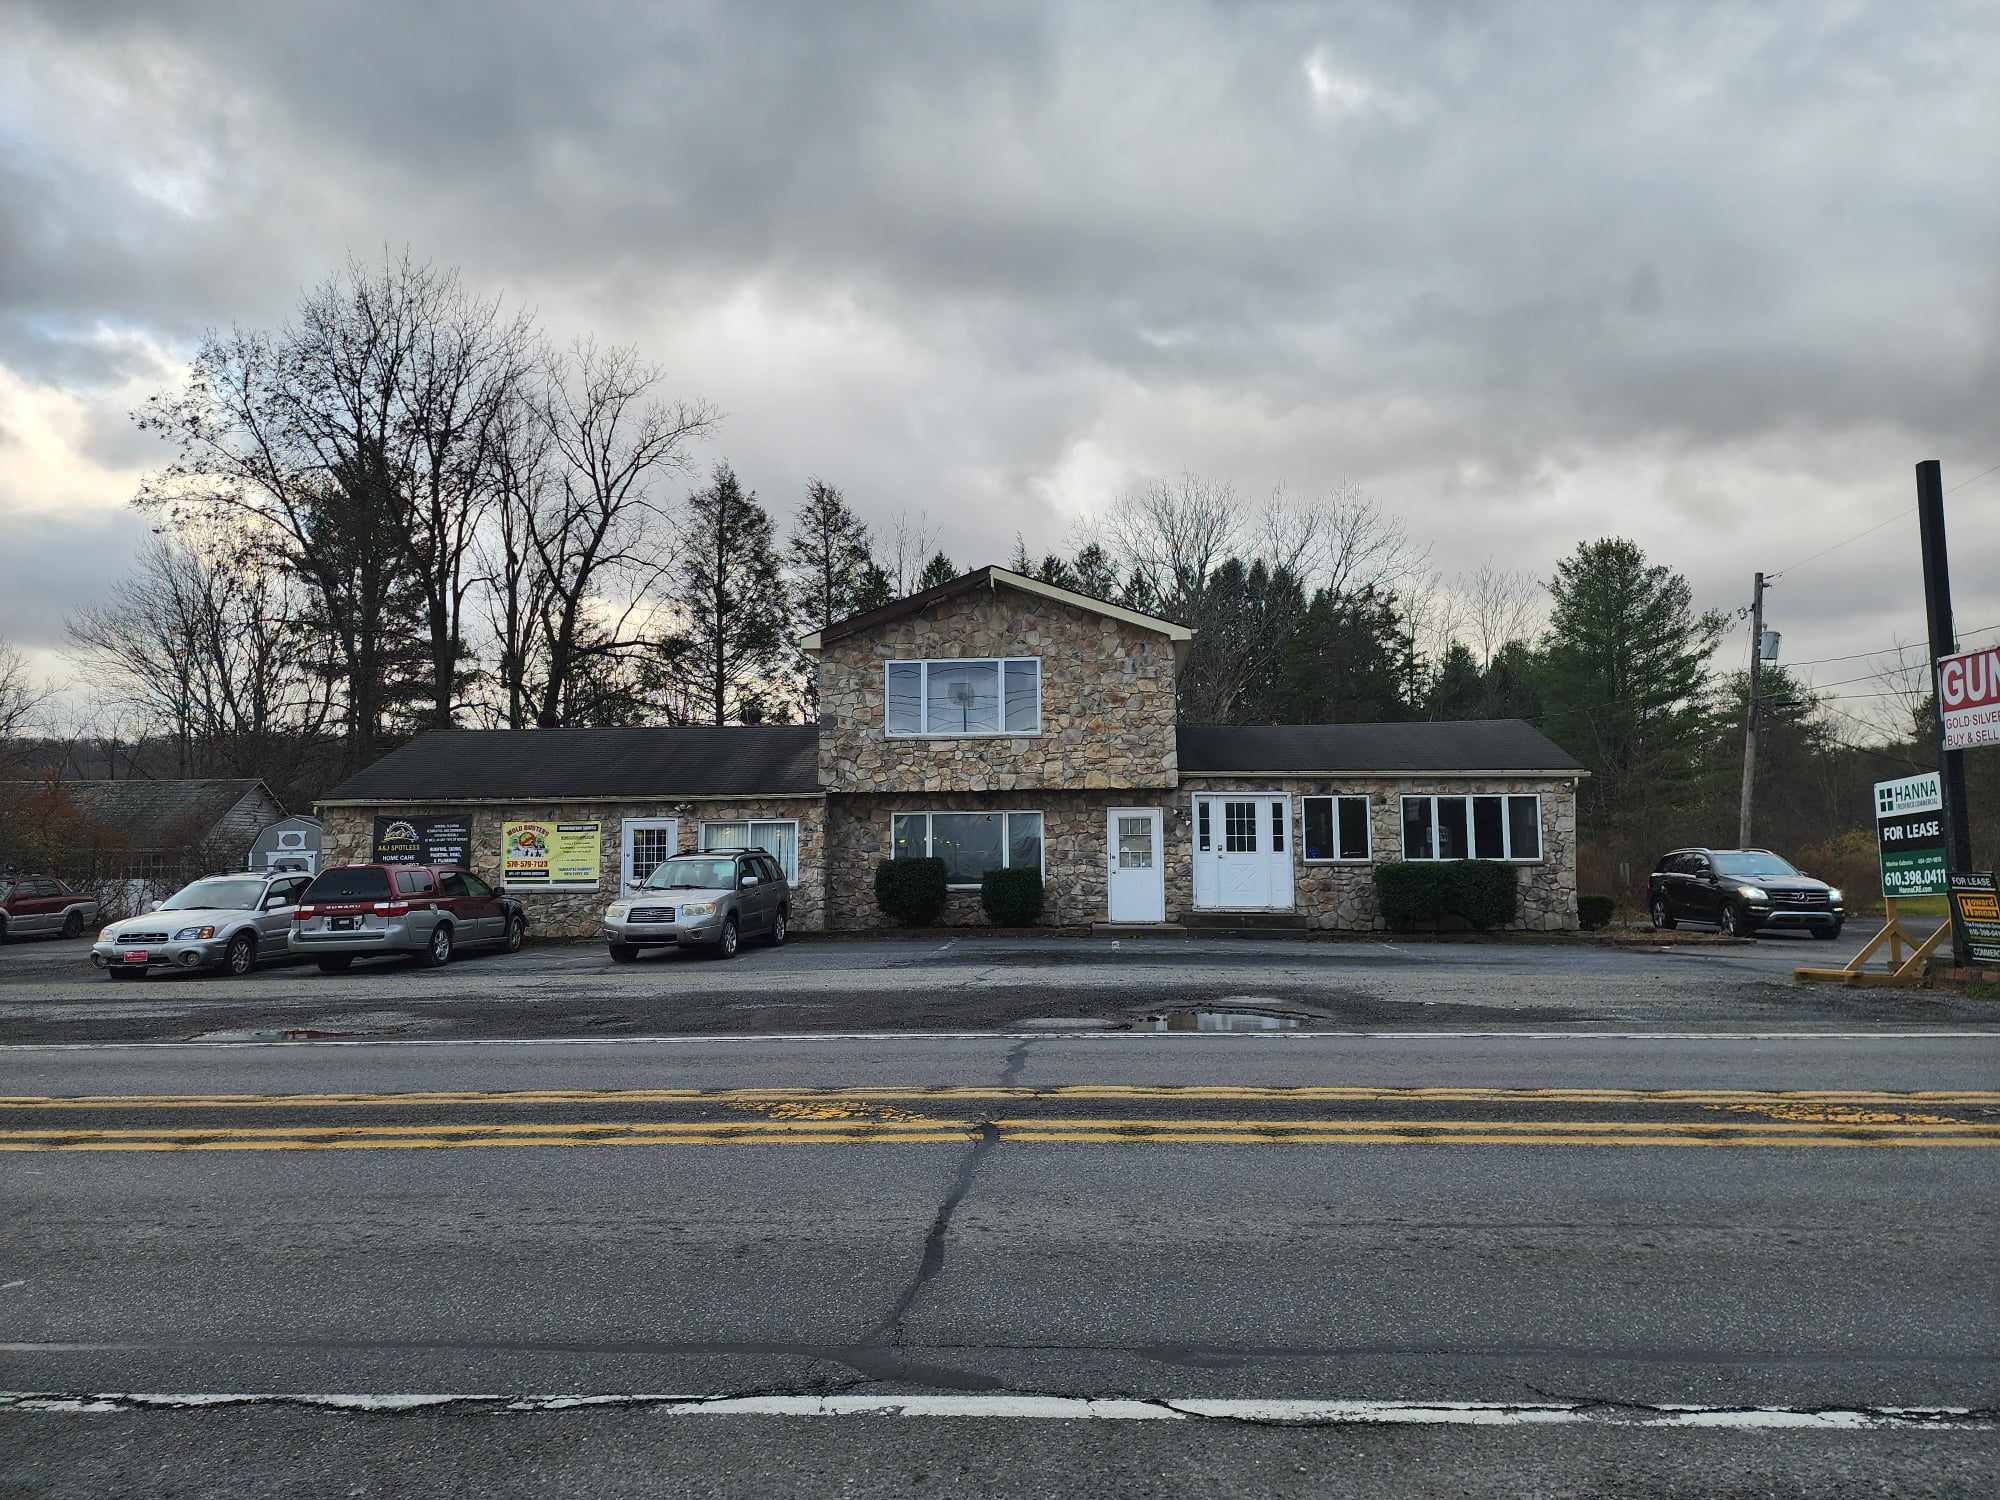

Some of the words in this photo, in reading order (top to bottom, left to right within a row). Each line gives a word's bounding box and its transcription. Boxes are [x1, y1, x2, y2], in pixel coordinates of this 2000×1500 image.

[1946, 715, 1970, 730] GOLD
[1947, 732, 1964, 746] BUY
[1967, 731, 1974, 744] &
[1976, 729, 1999, 742] SELL
[1895, 780, 1937, 802] HANNA
[506, 825, 523, 836] MOLD
[523, 824, 550, 836] BUSTERS
[1883, 825, 1904, 841] FOR
[1906, 821, 1940, 839] LEASE
[506, 860, 548, 868] 570-579-7123
[1885, 868, 1946, 886] 610.398.0411
[1952, 876, 1967, 886] FOR
[1968, 877, 1991, 887] LEASE
